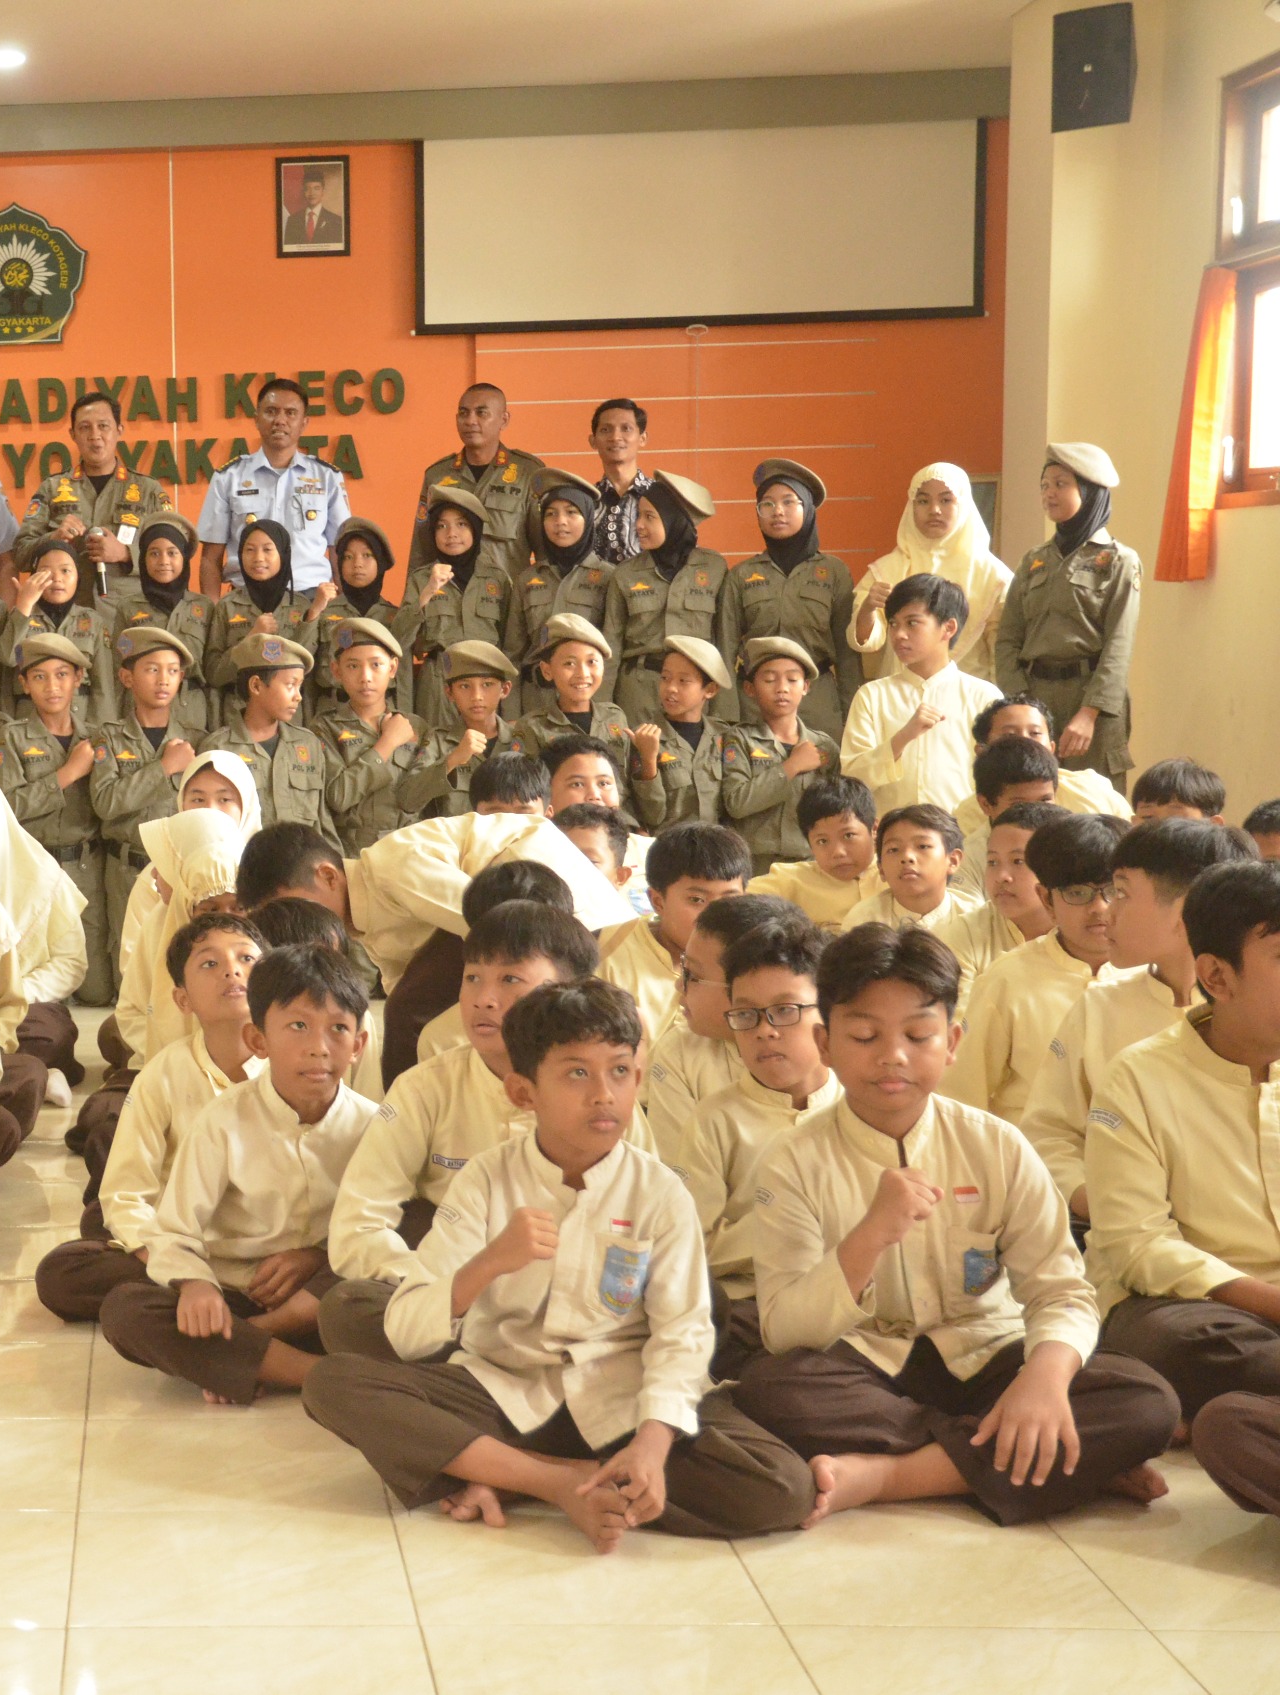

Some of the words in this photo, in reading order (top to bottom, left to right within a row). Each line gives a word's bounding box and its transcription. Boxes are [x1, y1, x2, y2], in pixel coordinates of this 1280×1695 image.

[19, 223, 49, 241] KLECO
[47, 239, 69, 289] KOTAGEDE
[224, 368, 406, 420] KECO
[2, 434, 364, 488] YOYAKTA
